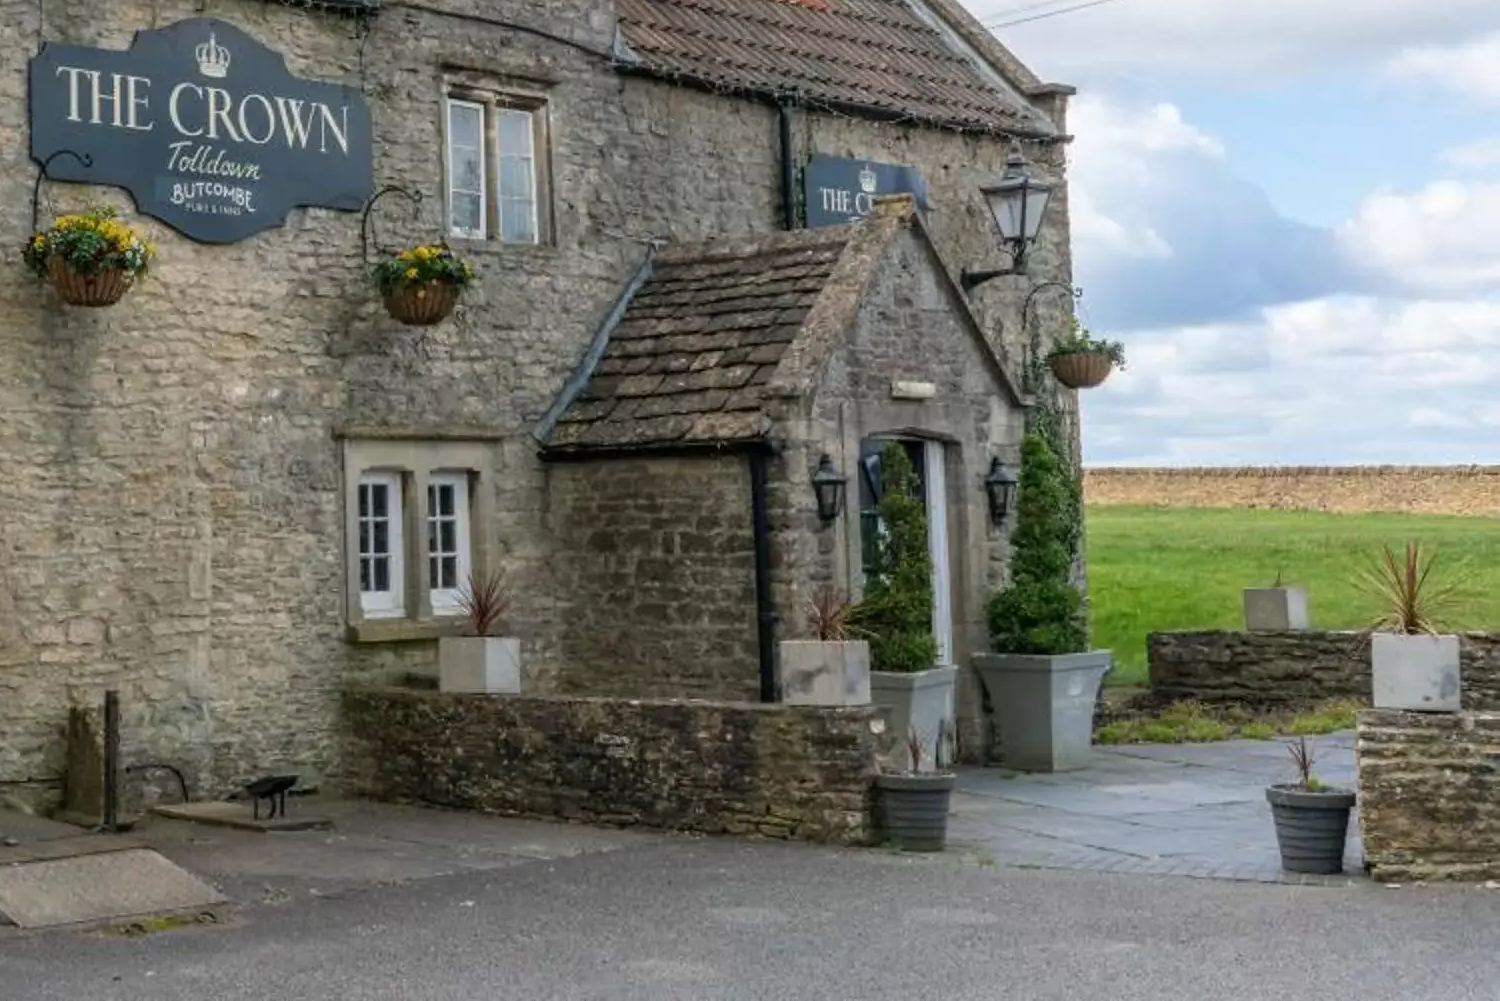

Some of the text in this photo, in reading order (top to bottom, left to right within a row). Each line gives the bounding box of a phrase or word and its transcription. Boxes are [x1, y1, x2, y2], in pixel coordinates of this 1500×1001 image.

[55, 65, 349, 156] THE CROWN
[167, 140, 261, 181] Tolldown
[169, 182, 257, 213] BUTCOMBE
[819, 186, 853, 215] THE
